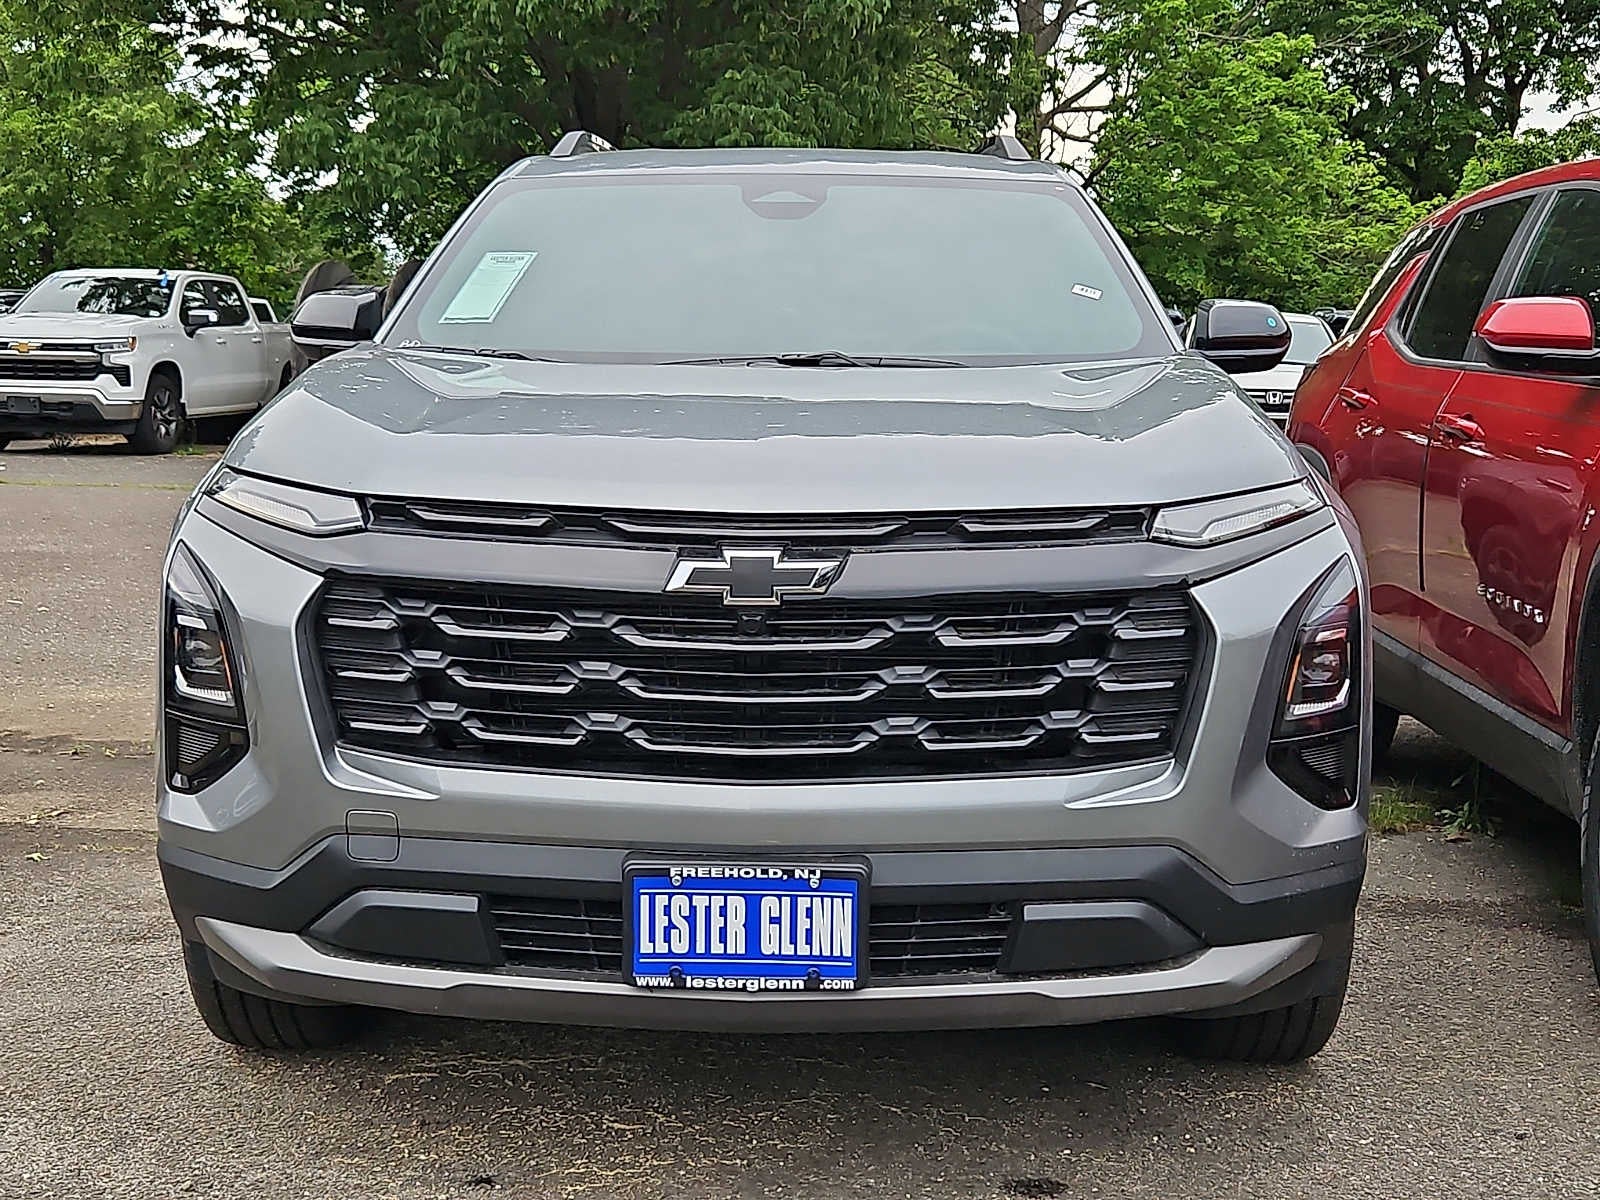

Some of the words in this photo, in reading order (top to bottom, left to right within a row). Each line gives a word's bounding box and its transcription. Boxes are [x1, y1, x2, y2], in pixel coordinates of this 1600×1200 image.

[670, 867, 787, 880] FREEHOLD,
[794, 868, 821, 880] NJ
[640, 894, 746, 954] LESTER
[761, 896, 852, 957] GLENN
[635, 976, 675, 987] www.
[685, 976, 804, 991] lesterglenn
[819, 978, 854, 989] .com
